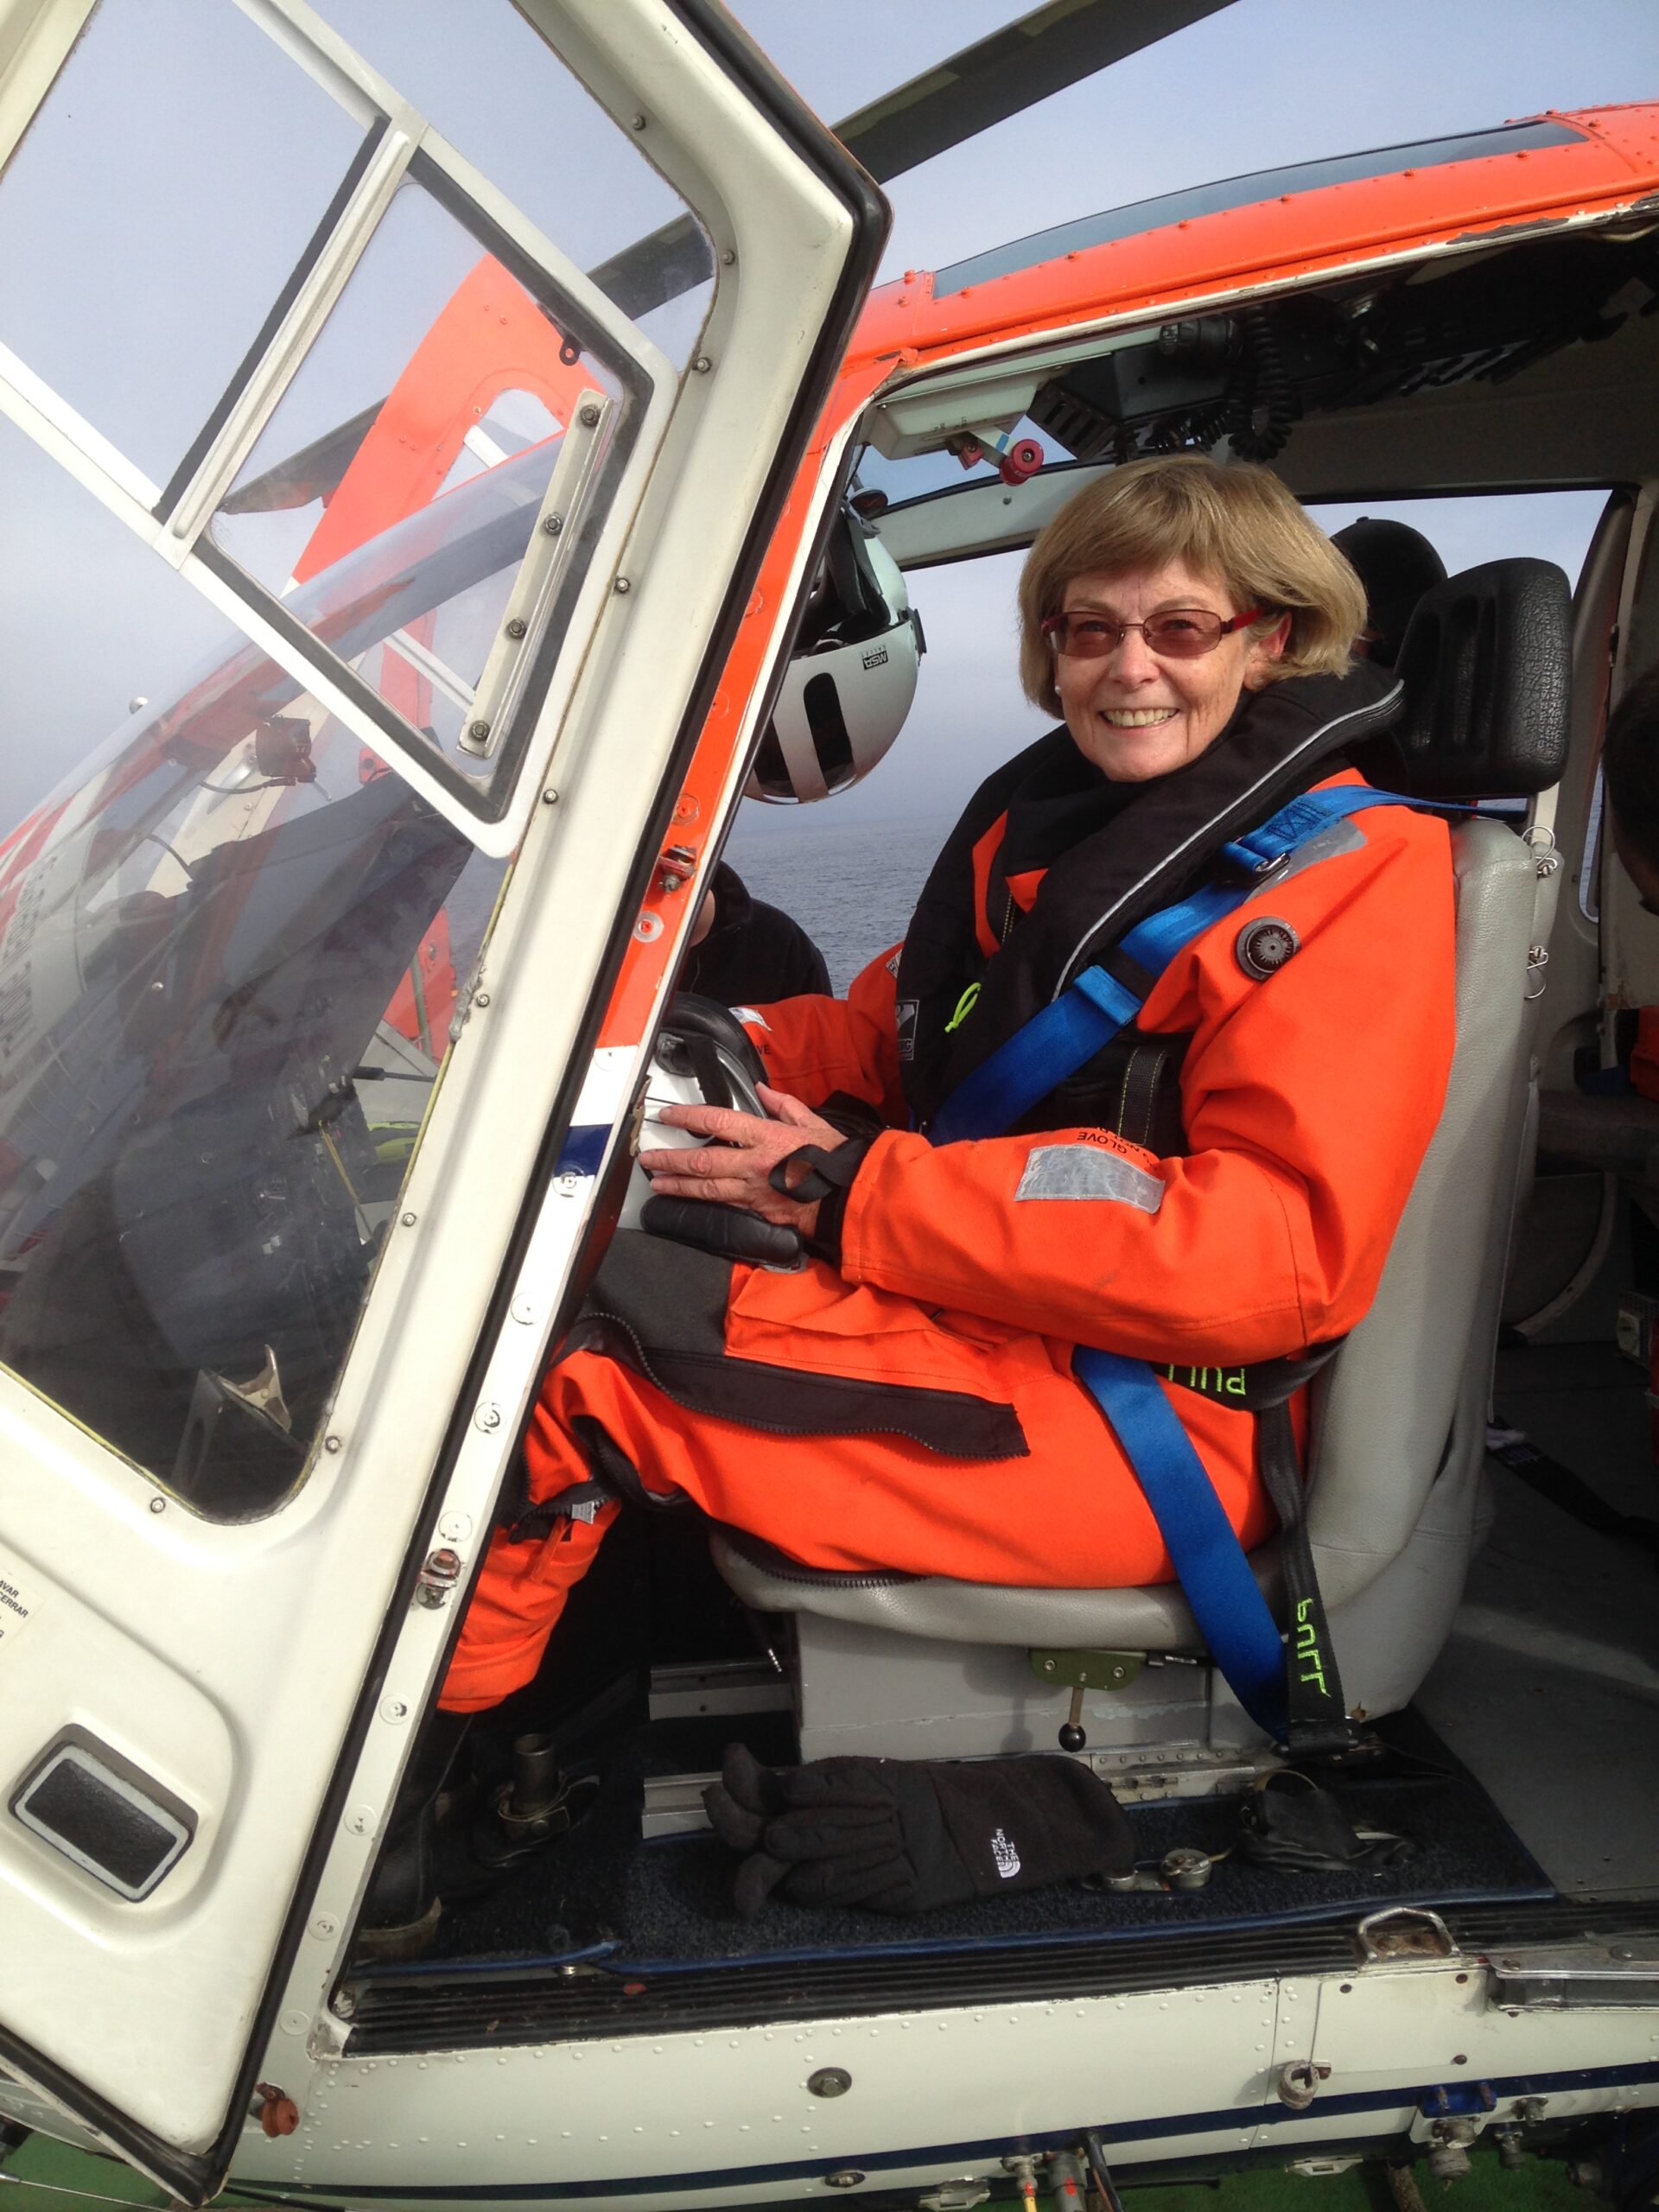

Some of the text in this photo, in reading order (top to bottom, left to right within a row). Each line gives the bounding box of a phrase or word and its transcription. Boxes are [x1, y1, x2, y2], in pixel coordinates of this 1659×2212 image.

[864, 653, 887, 668] MSA
[1077, 1132, 1127, 1154] GLOVE
[991, 1839, 1003, 1862] FACE
[995, 1828, 1011, 1862] NORTH
[1007, 1841, 1019, 1861] THE
